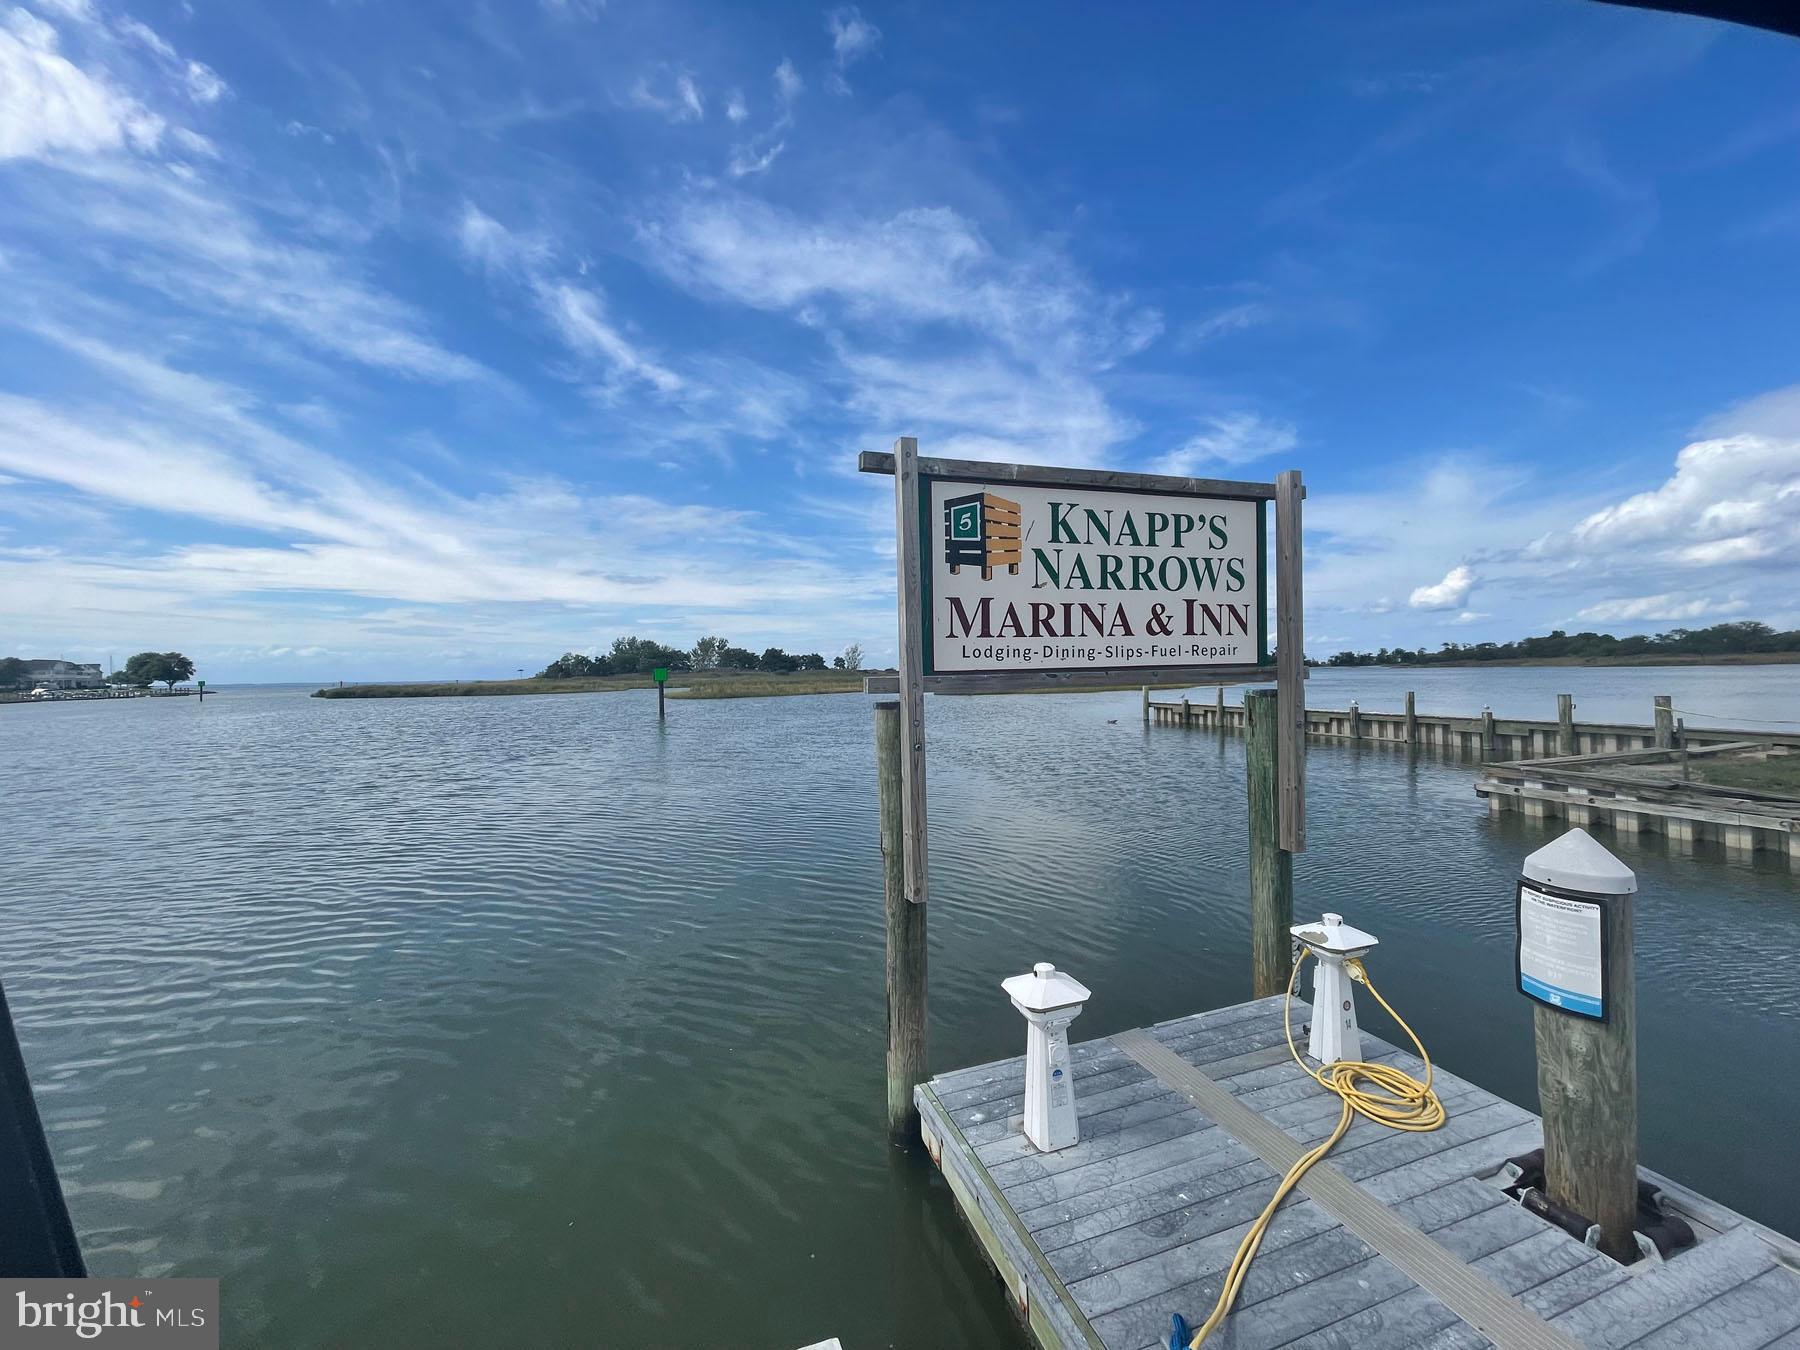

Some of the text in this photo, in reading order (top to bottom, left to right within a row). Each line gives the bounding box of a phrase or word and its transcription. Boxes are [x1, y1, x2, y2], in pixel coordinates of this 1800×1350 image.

[959, 512, 972, 531] 5
[1047, 501, 1228, 551] KNAPP'S
[1031, 547, 1246, 593] NARROWS
[945, 596, 1250, 639] MARINA & INN
